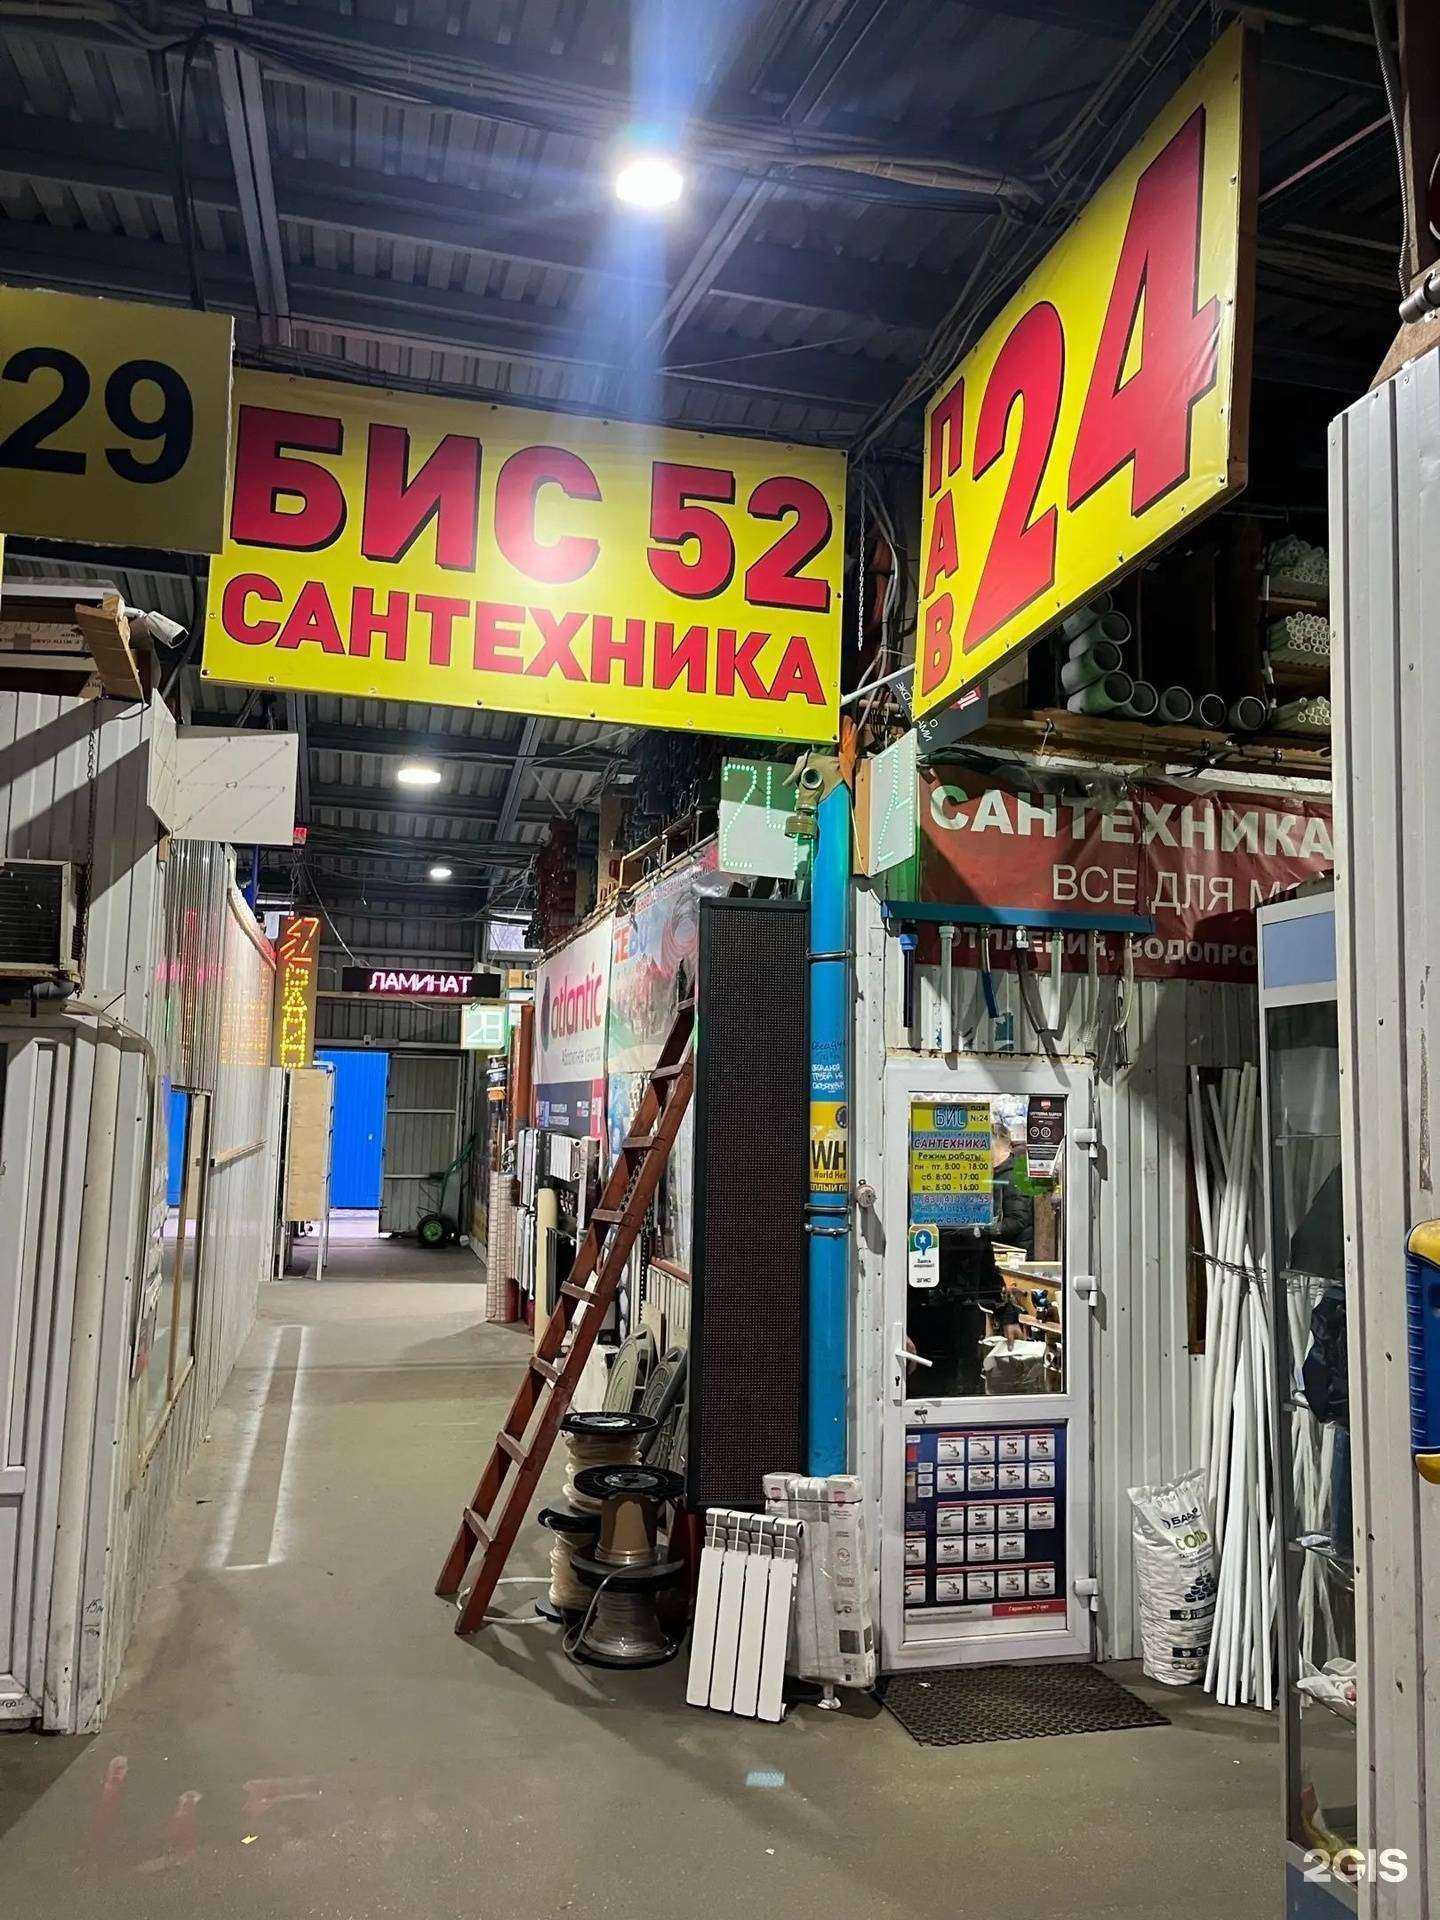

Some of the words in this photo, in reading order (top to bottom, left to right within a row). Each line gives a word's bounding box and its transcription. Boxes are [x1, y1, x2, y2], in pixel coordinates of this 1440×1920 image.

[962, 103, 1222, 656] 24
[0, 346, 194, 485] 29
[230, 403, 604, 585] БИС
[646, 459, 832, 614] 52
[220, 572, 827, 707] САНТЕХНИКА
[929, 784, 1335, 861] САНТЕХНИКА
[1051, 863, 1138, 905] ВСЕ
[1150, 870, 1234, 917] ДЛЯ
[369, 971, 473, 994] ЛАМИНАТ
[550, 961, 603, 1041] atlantic
[914, 1139, 987, 1149] САНТЕХНИКА
[936, 1107, 966, 1127] БИС
[811, 1140, 847, 1170] WH
[918, 1151, 946, 1160] Режим
[959, 1173, 979, 1181] 17:00
